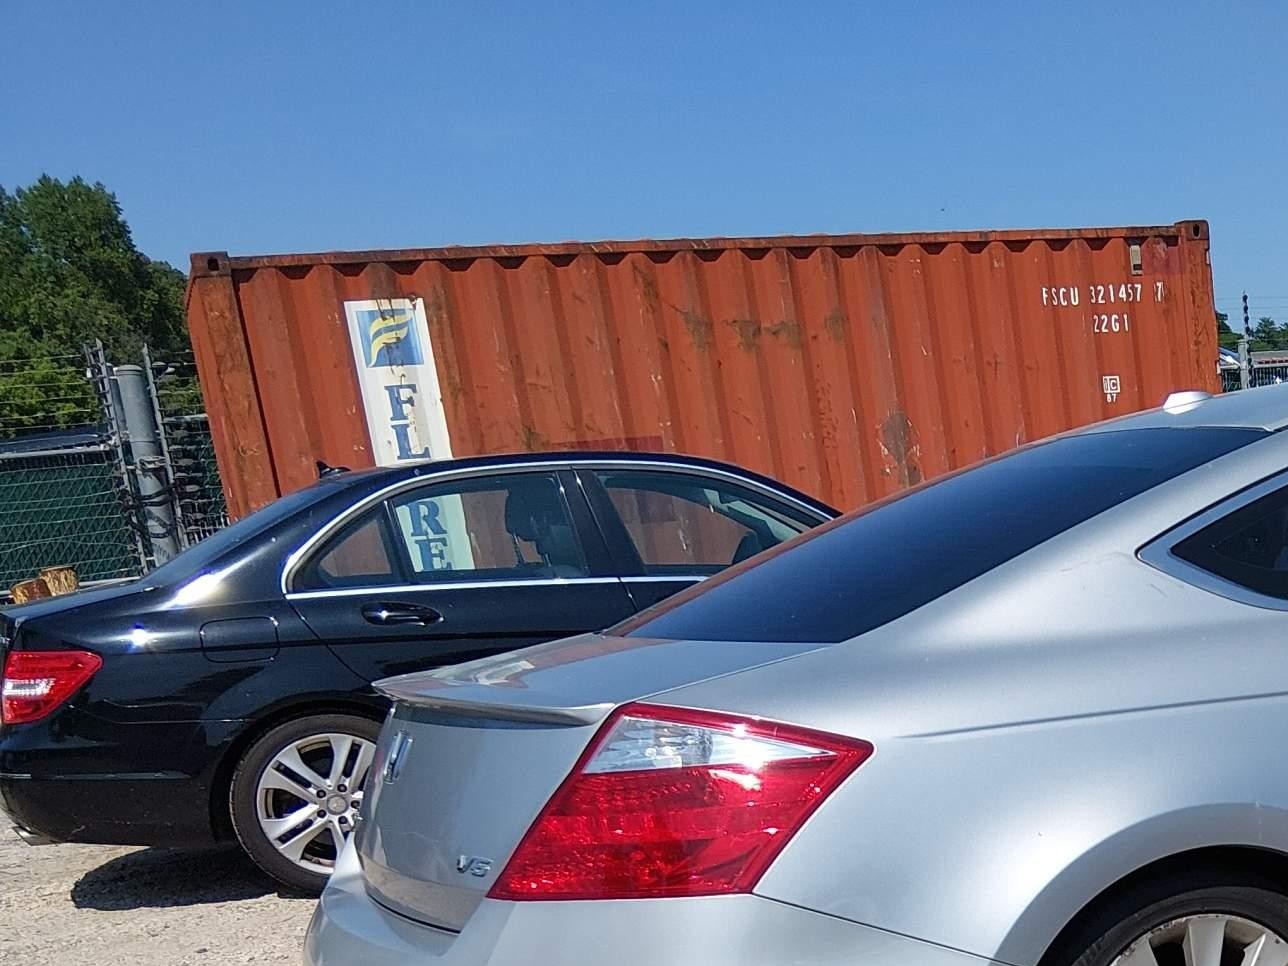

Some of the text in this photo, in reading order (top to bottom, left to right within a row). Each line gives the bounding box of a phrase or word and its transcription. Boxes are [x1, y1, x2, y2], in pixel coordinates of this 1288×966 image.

[1042, 286, 1079, 306] FSCU
[1089, 284, 1141, 304] 321457
[1093, 313, 1128, 333] 22G1
